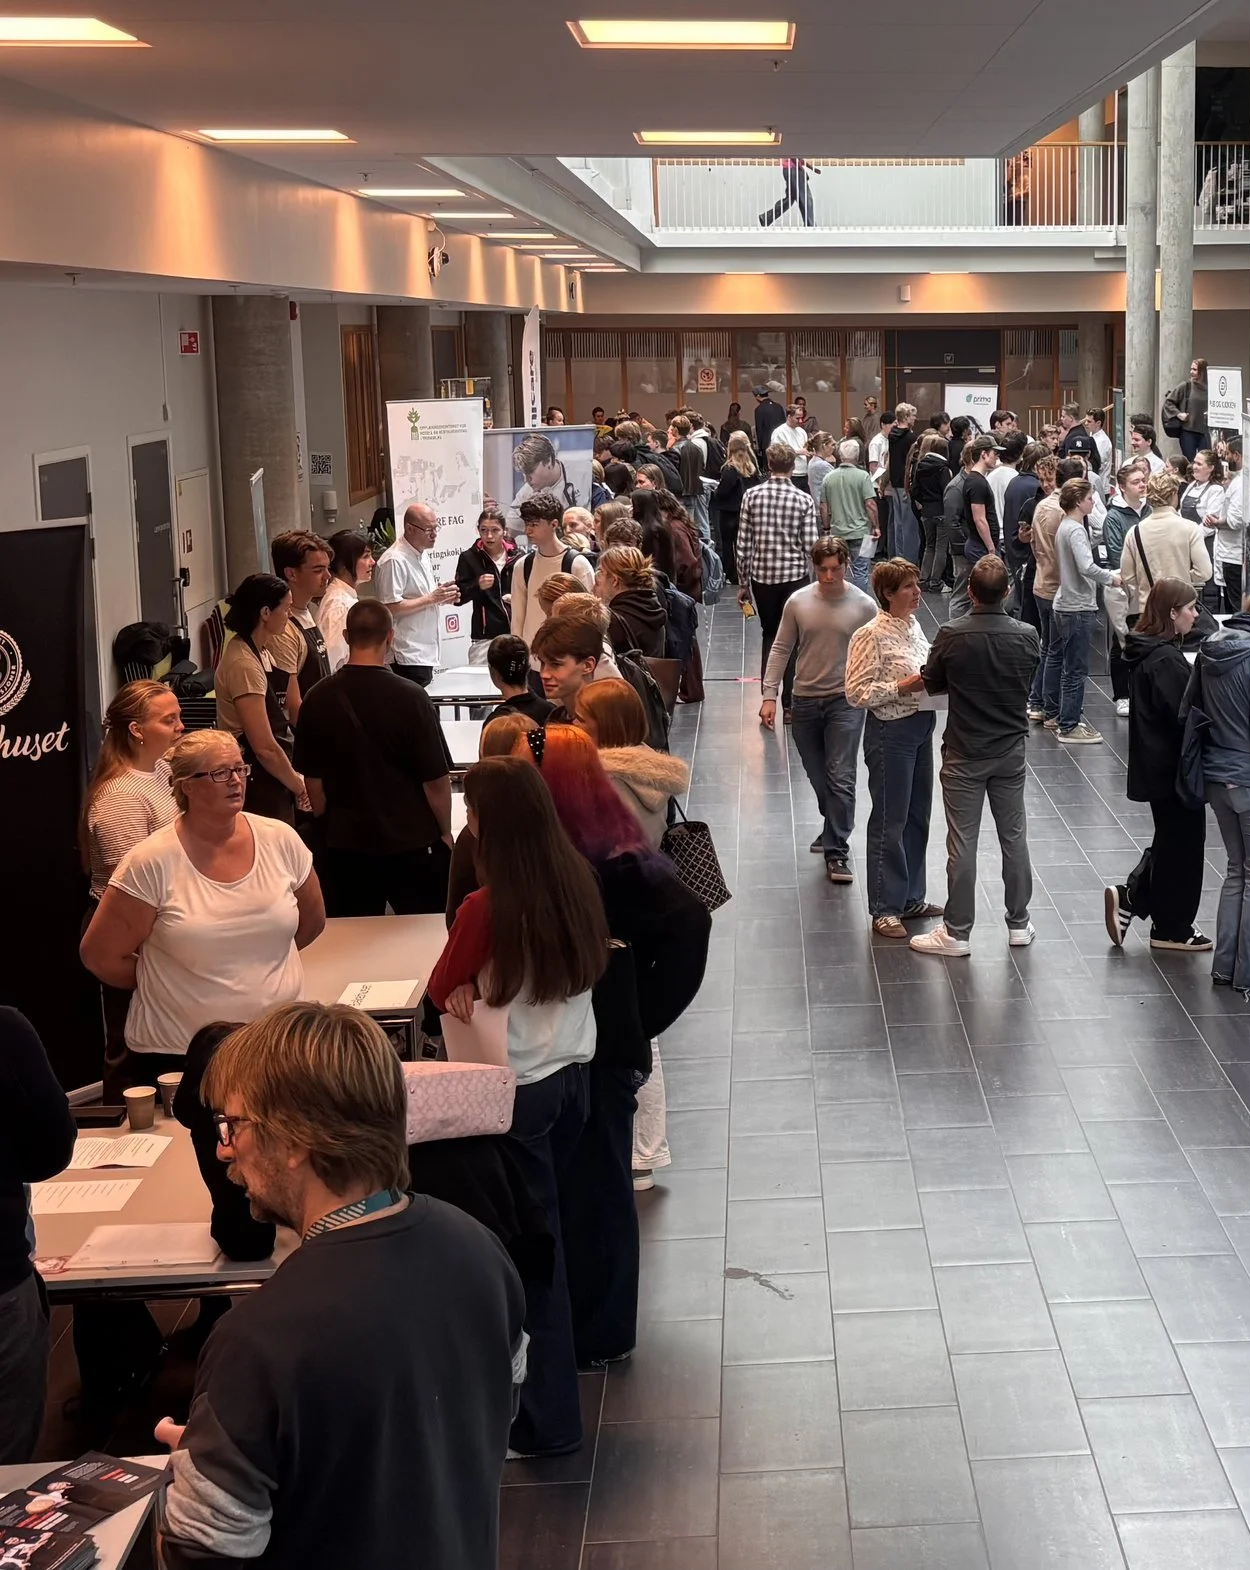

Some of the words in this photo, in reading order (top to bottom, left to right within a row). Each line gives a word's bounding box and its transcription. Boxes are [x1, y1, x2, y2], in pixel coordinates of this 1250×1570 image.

[974, 395, 991, 404] prima
[448, 515, 464, 526] FAG
[428, 546, 465, 561] ringskok
[0, 721, 70, 761] huset
